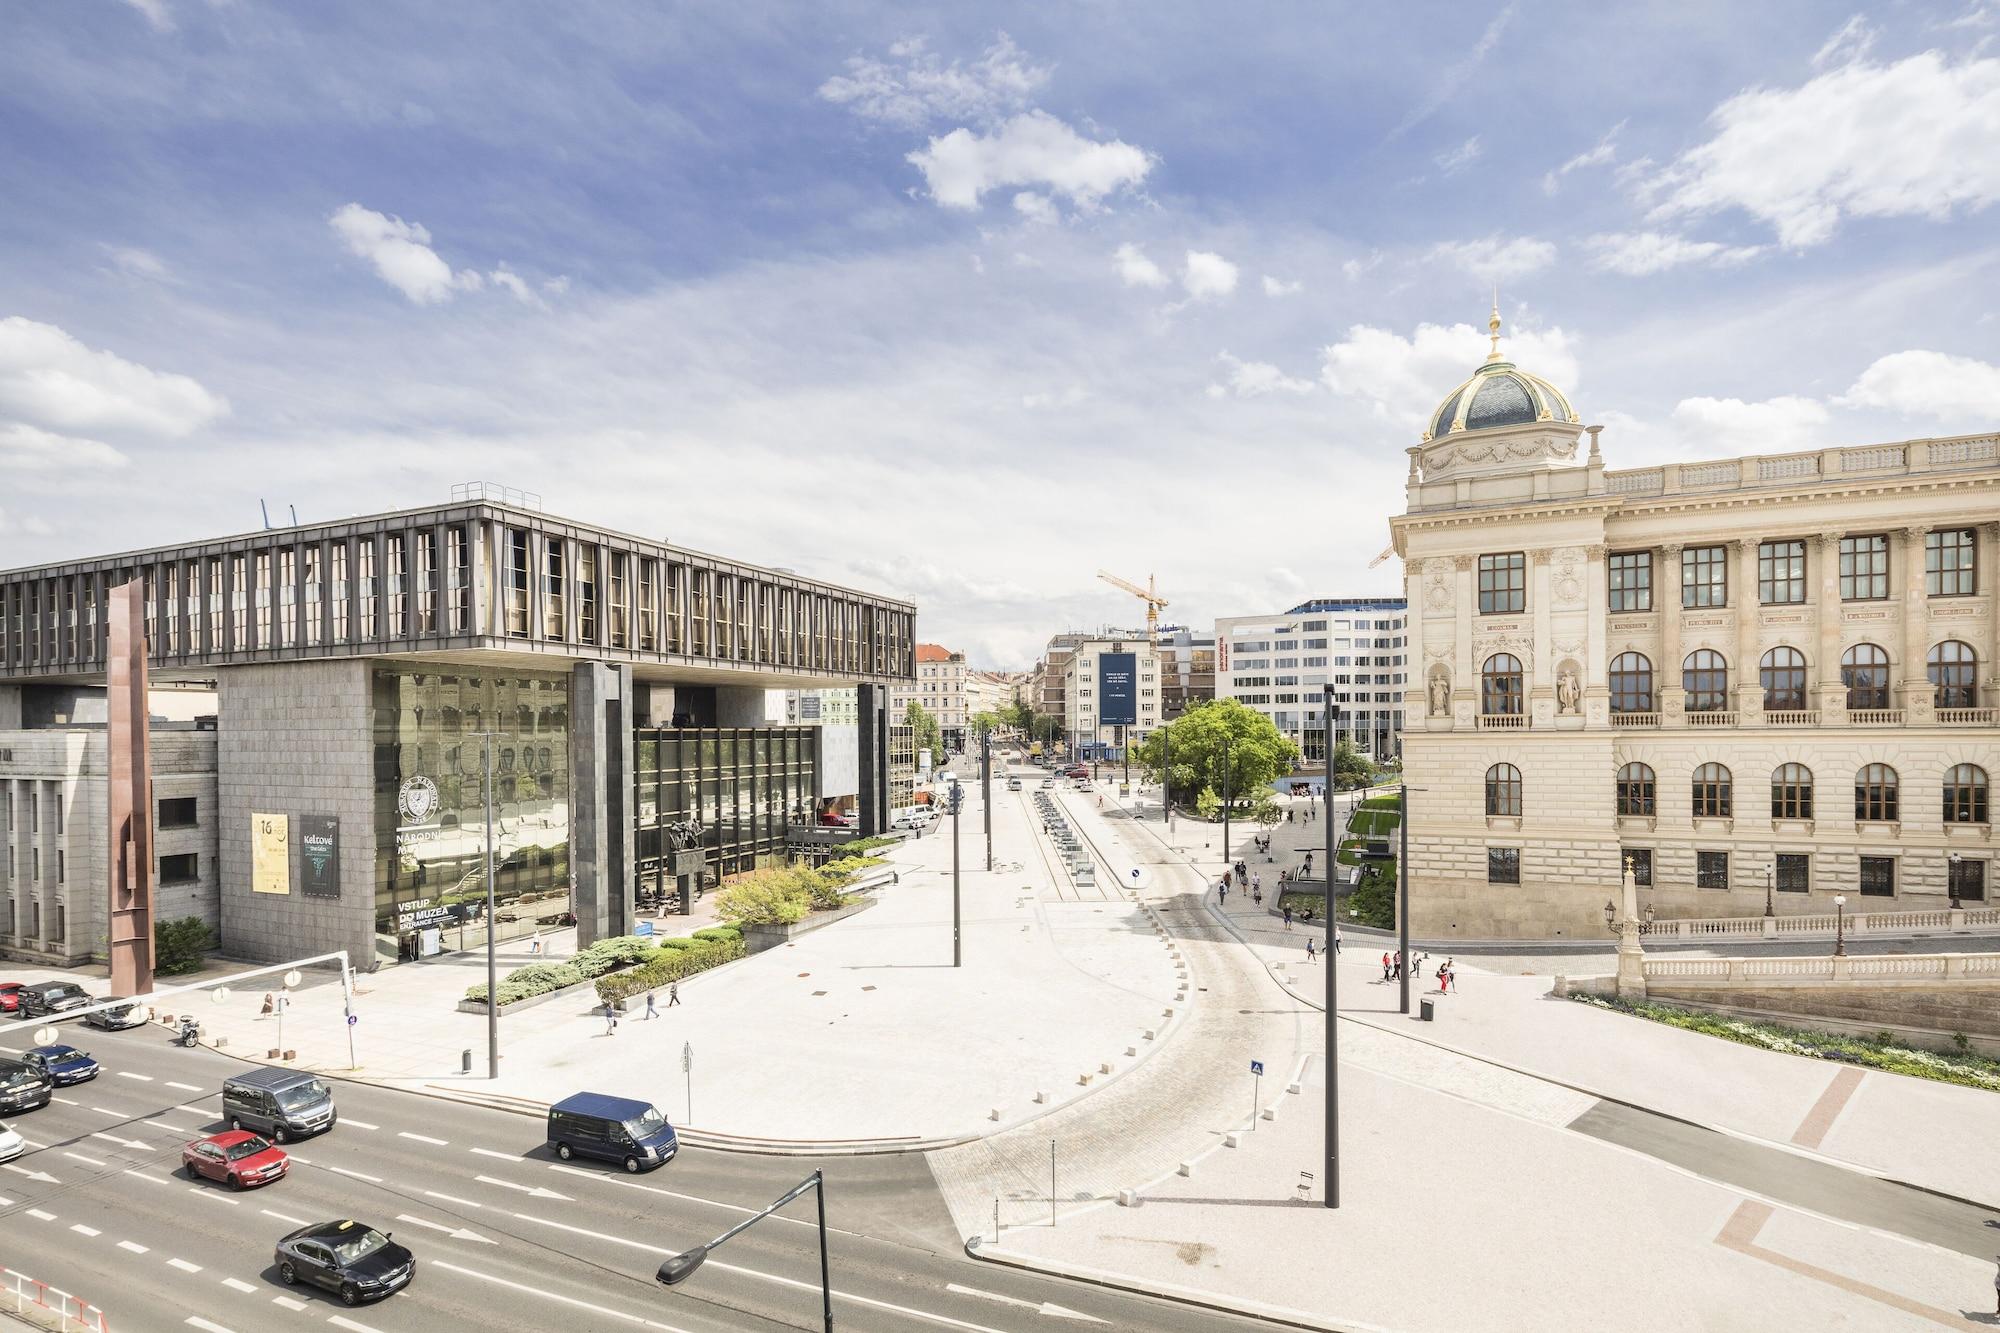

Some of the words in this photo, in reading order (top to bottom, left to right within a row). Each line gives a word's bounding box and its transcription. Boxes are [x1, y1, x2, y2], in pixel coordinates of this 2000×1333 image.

[0, 748, 12, 761] M
[304, 834, 333, 846] Keltové
[398, 899, 430, 912] VSTUP
[400, 912, 414, 924] DO
[416, 907, 449, 920] MUZEA
[400, 918, 433, 930] ENTRANCE
